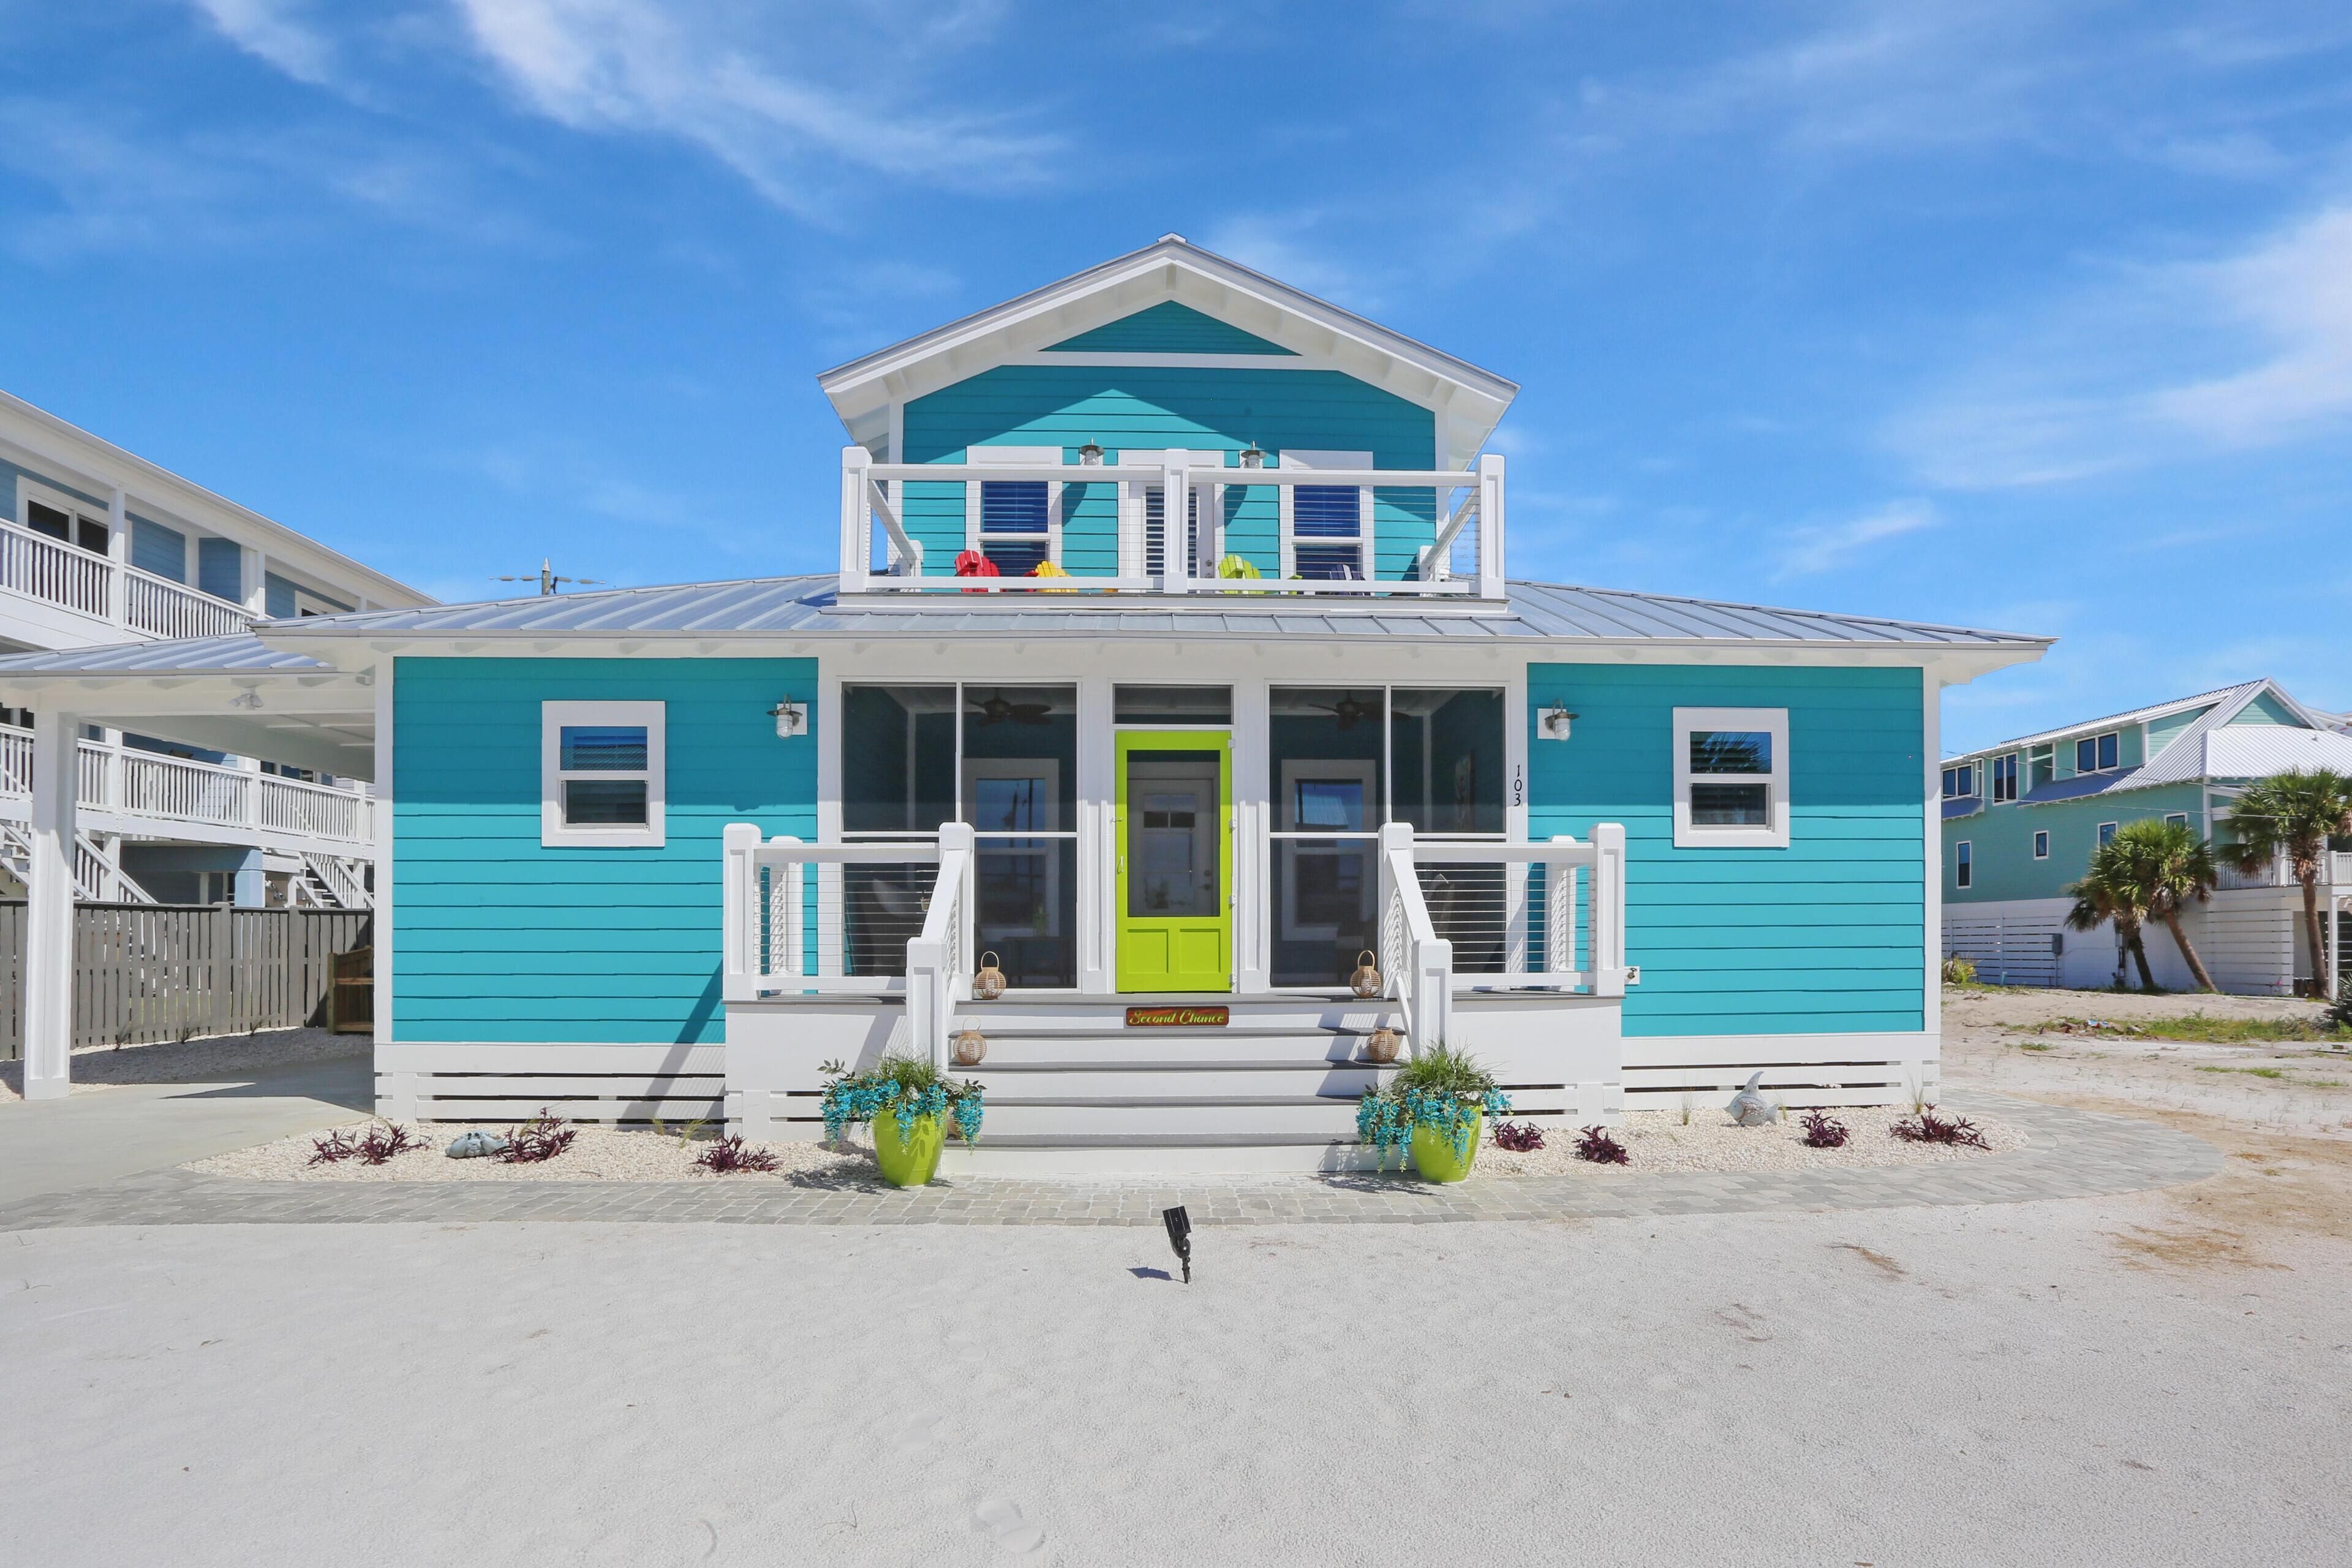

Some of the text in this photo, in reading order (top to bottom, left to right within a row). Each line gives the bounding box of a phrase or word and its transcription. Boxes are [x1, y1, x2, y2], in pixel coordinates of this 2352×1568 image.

[1513, 764, 1522, 806] 103
[1129, 1009, 1224, 1024] Second Chance
